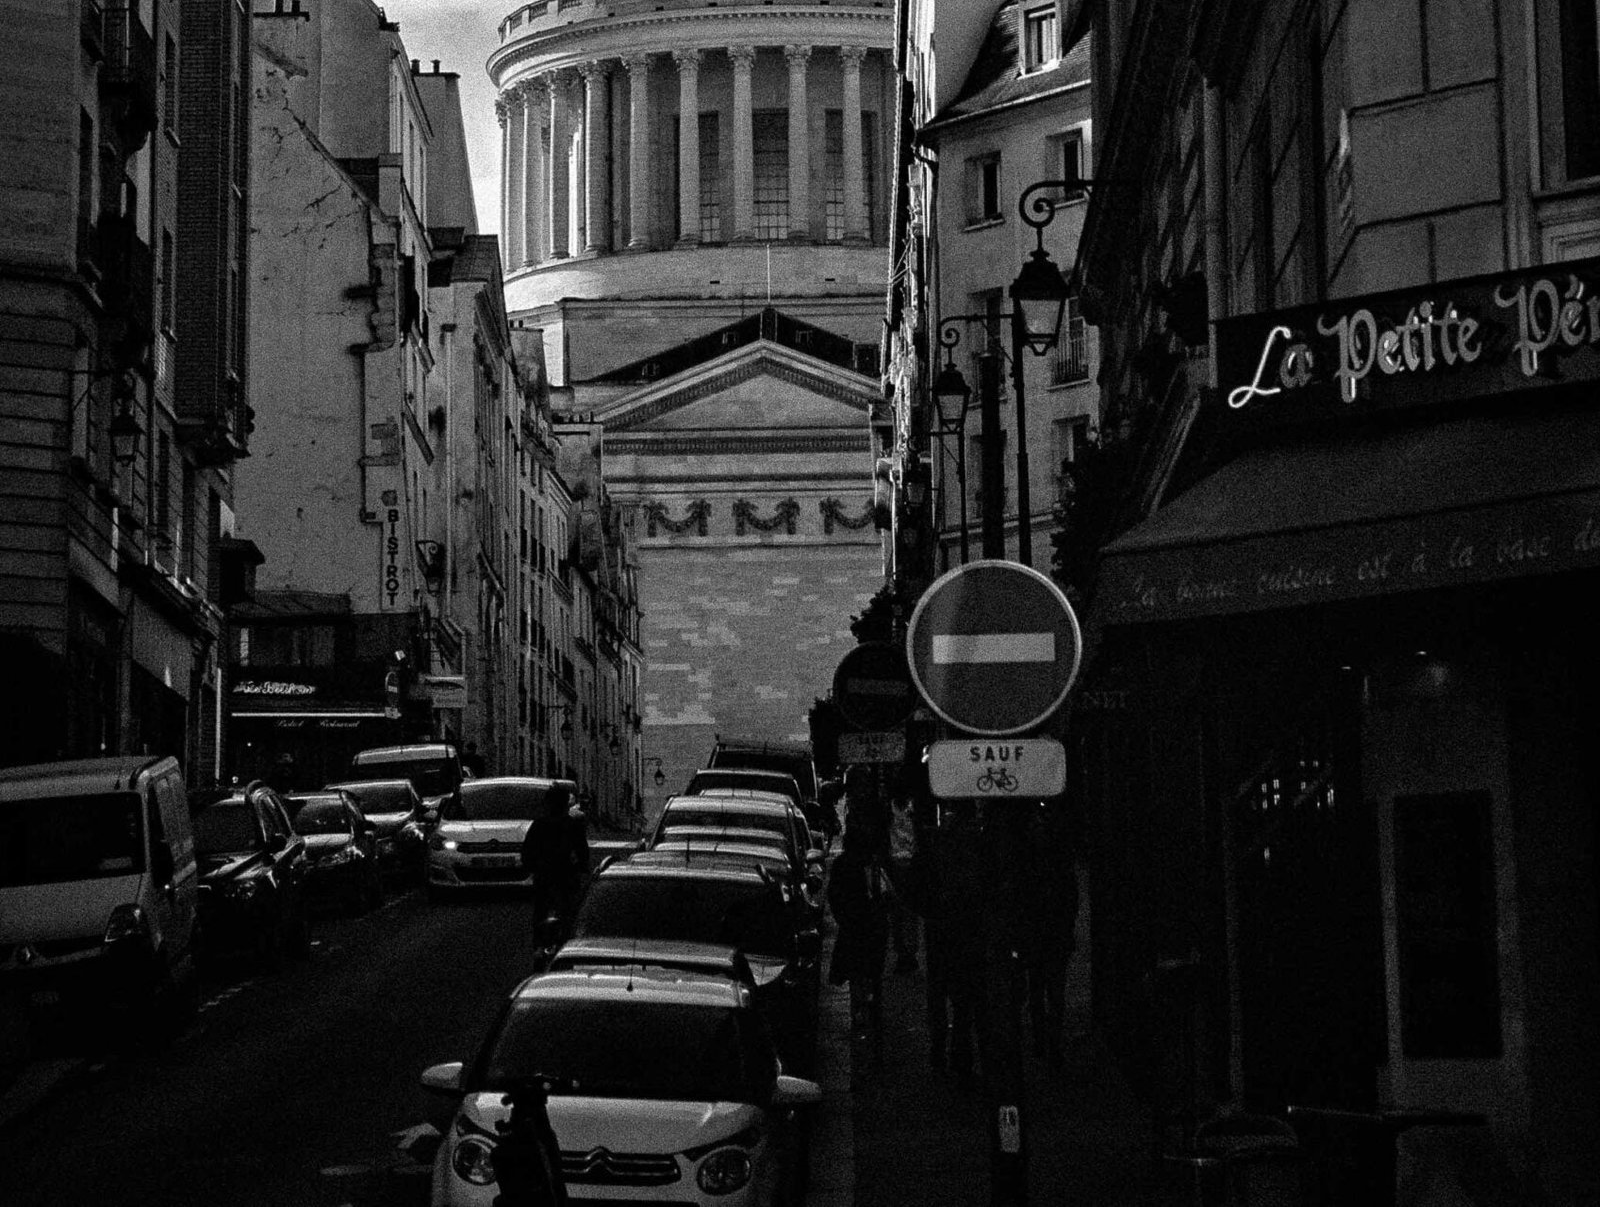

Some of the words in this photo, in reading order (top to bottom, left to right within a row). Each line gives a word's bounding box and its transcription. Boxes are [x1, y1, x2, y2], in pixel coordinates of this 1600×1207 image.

[1228, 325, 1314, 408] La
[1316, 300, 1483, 404] Petite
[385, 509, 400, 606] BISTROT
[1448, 536, 1475, 568] la
[969, 745, 1025, 762] SAUF
